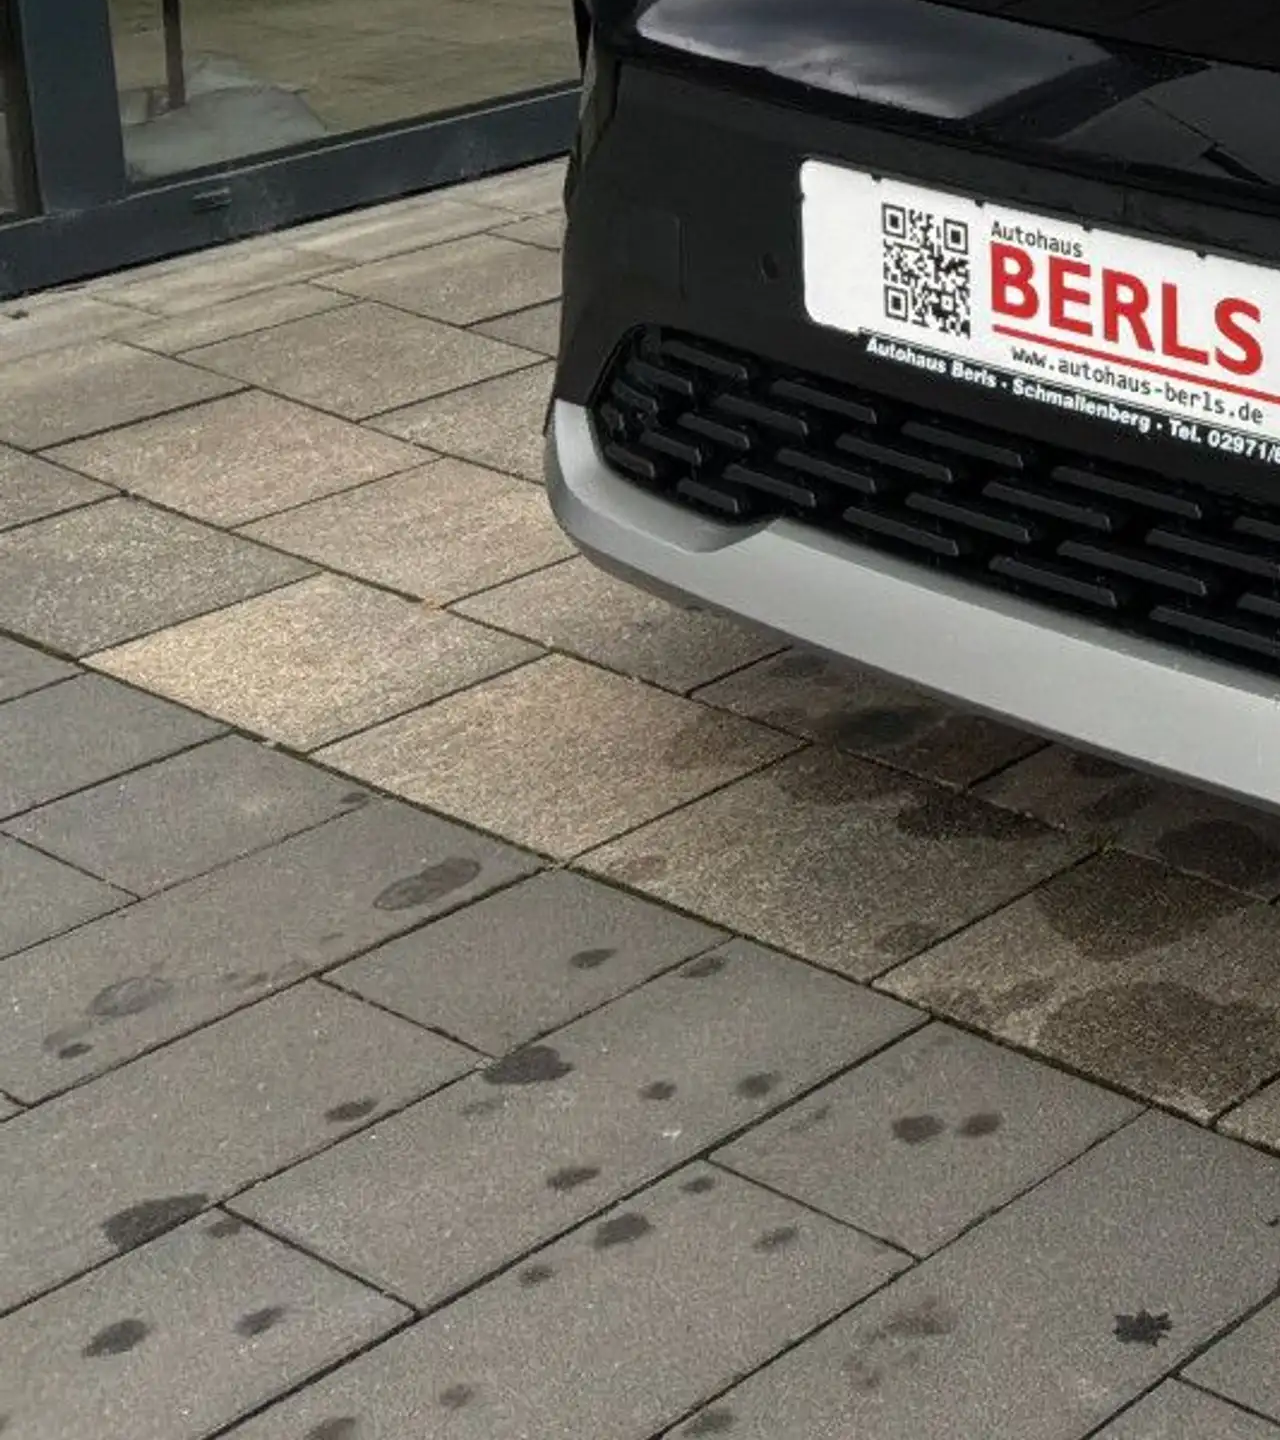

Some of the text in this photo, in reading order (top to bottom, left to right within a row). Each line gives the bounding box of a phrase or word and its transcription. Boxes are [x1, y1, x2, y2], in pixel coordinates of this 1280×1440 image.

[990, 220, 1085, 258] Autohaus
[989, 240, 1264, 376] BERLS
[866, 336, 947, 374] Autohaus
[950, 360, 998, 390] Berls
[1011, 378, 1152, 433] Schmallenberg
[1168, 418, 1202, 444] Tel.
[1010, 346, 1264, 425] www.autohaus-berls.de
